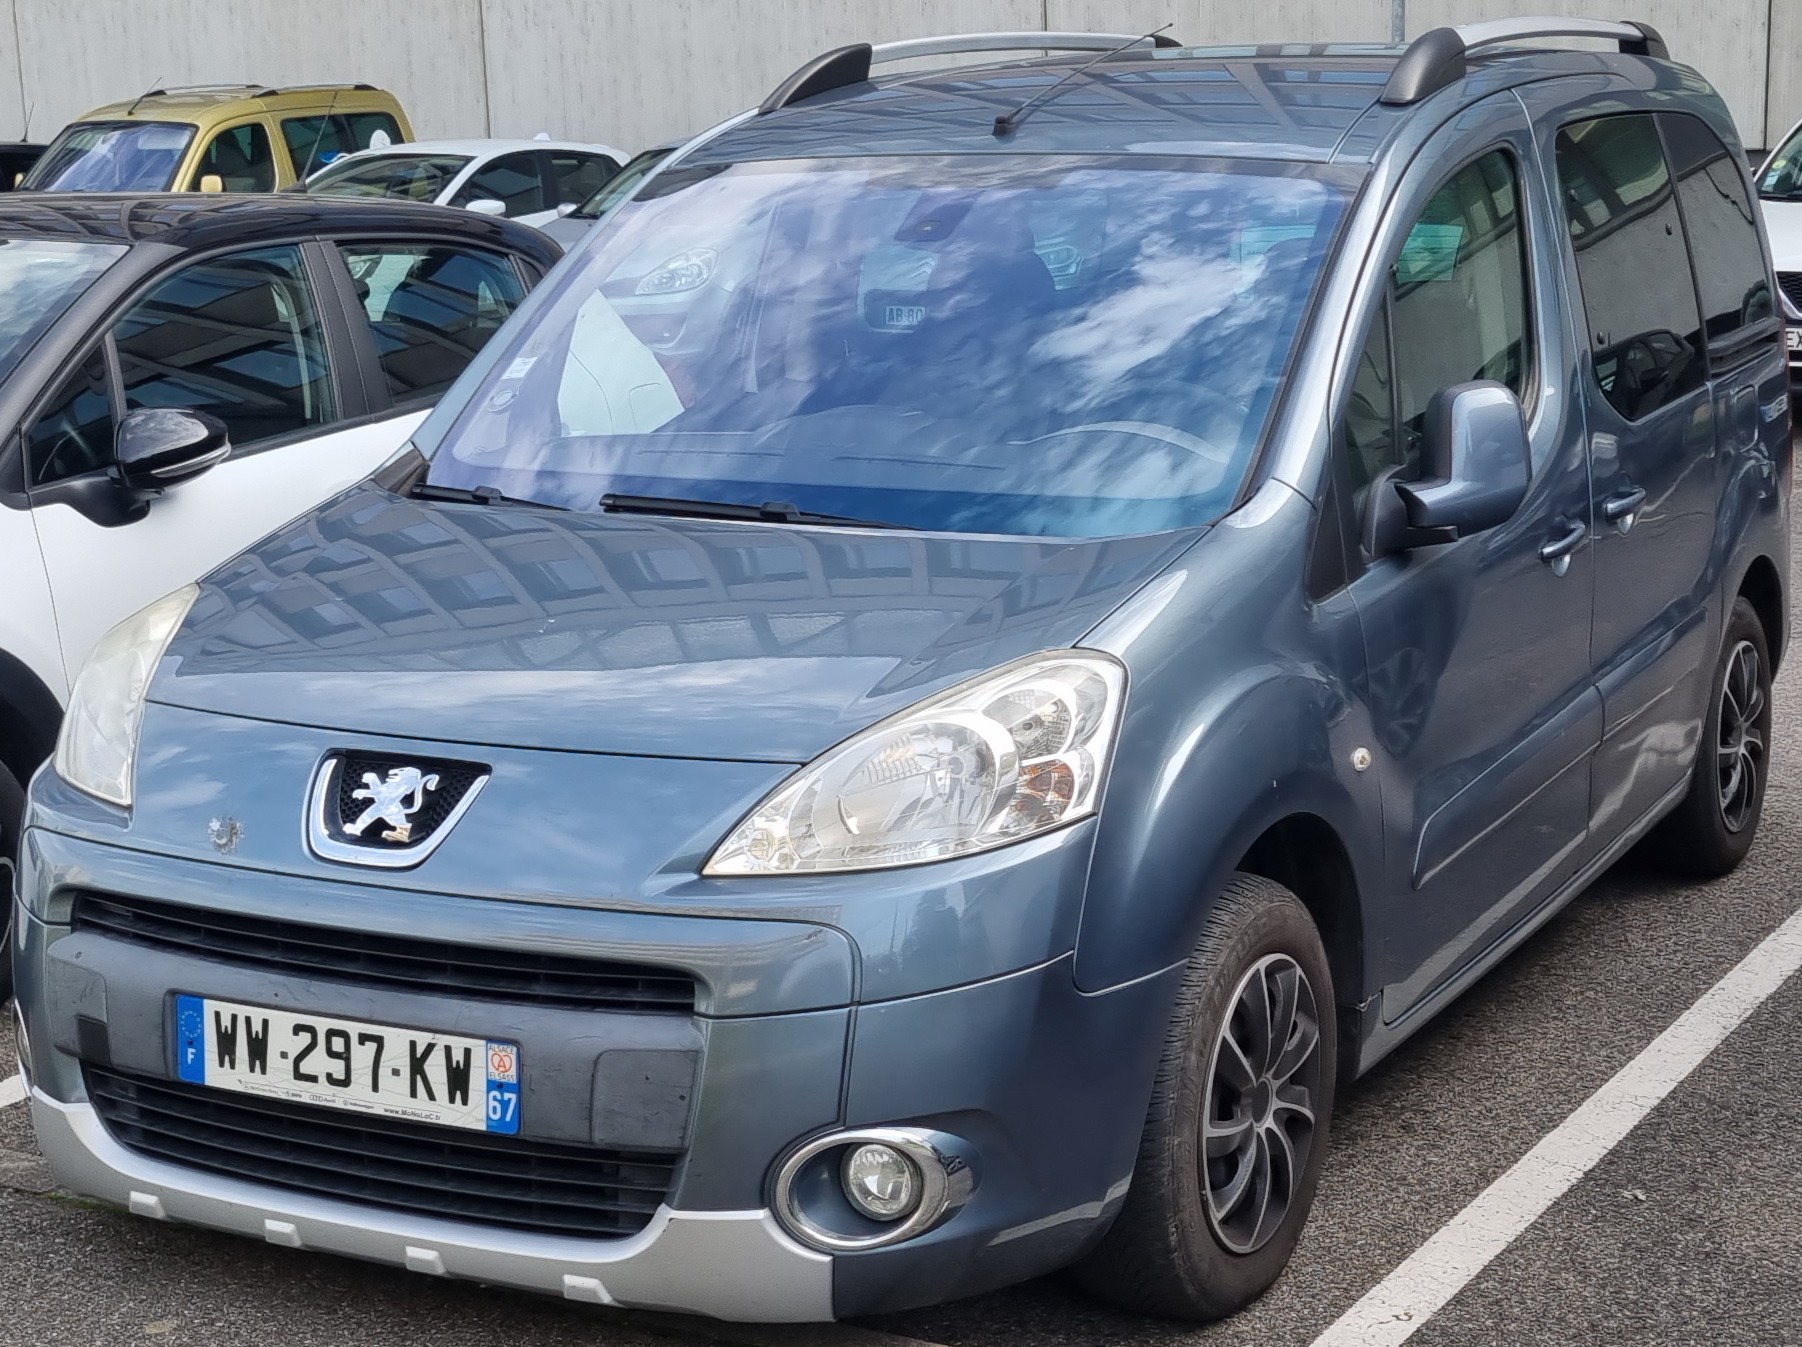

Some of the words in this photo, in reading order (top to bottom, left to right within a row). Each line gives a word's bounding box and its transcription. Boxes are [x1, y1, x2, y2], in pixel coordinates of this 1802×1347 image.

[187, 1047, 196, 1065] F
[489, 1044, 514, 1055] ALSACE
[490, 1071, 514, 1083] ELSASS
[488, 1090, 517, 1122] 67
